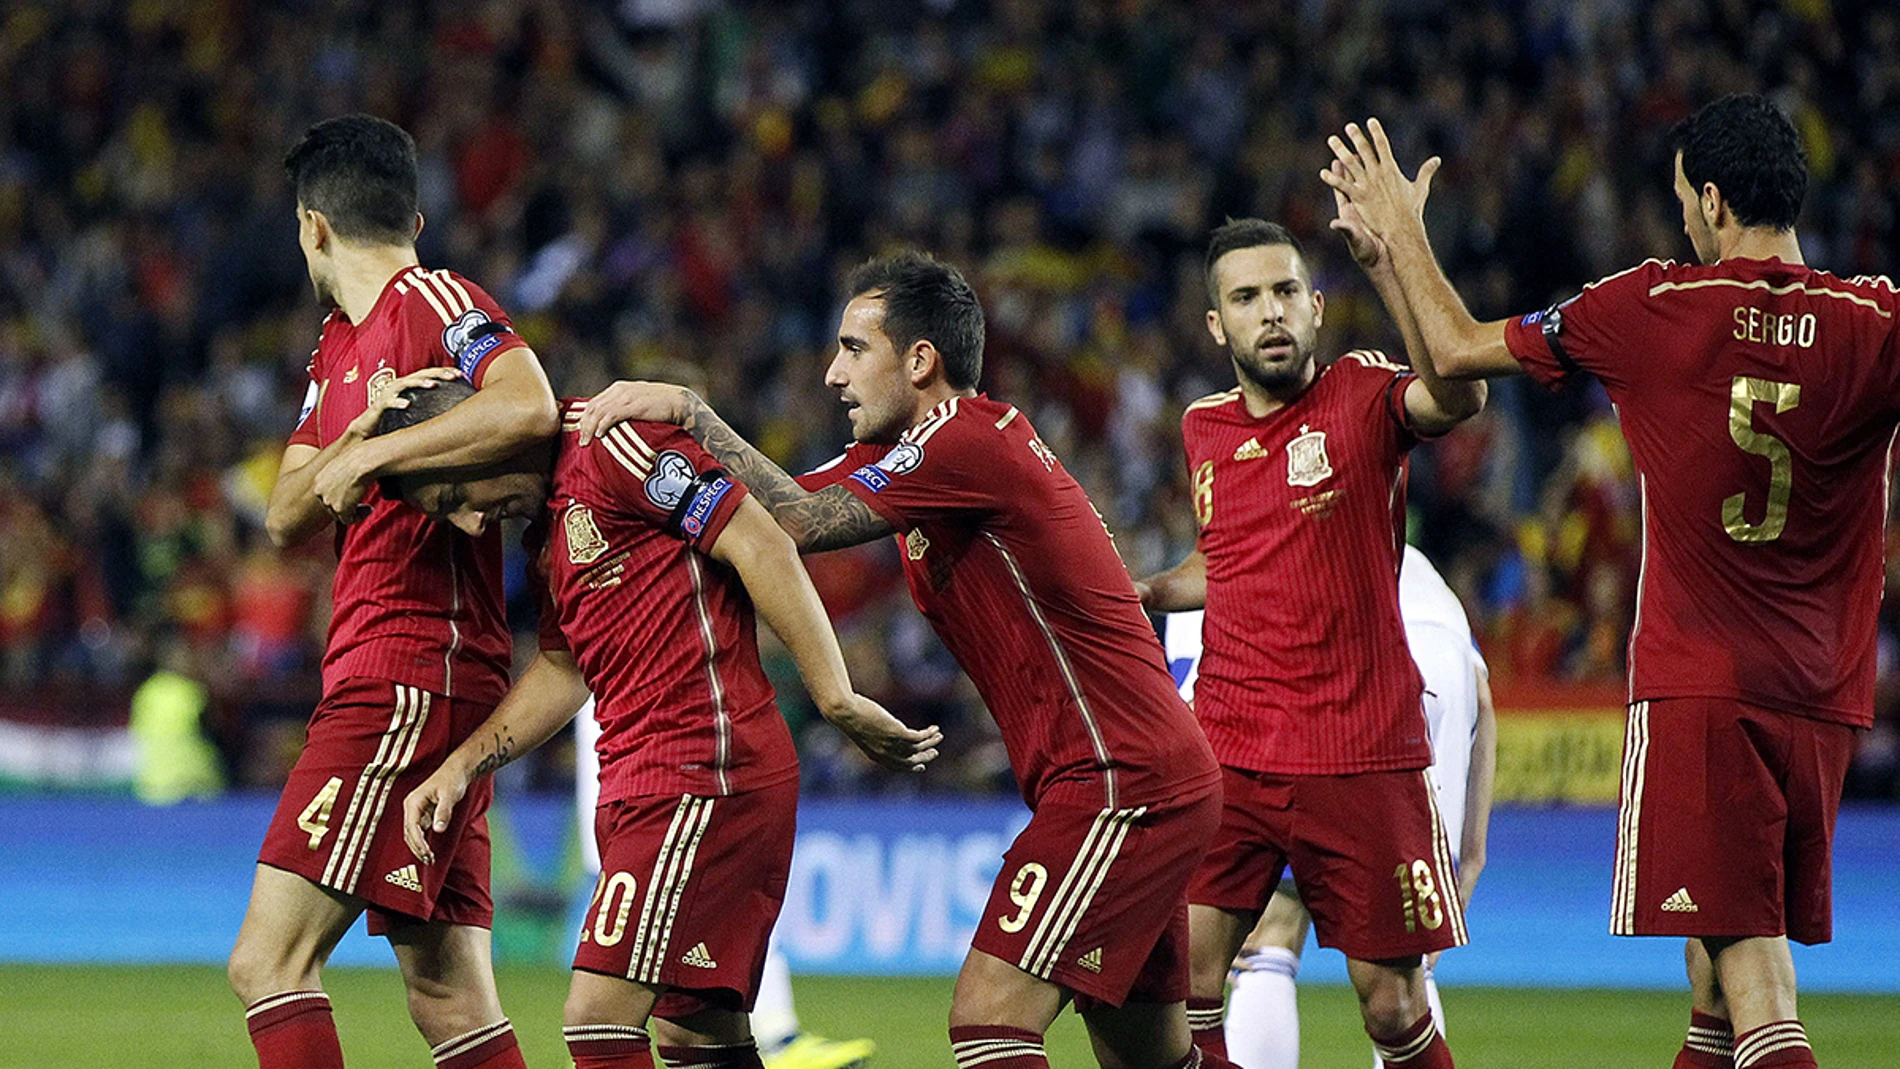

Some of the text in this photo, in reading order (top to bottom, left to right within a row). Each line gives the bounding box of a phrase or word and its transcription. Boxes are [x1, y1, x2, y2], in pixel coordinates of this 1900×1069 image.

[1732, 305, 1817, 348] SERGIO
[1721, 375, 1801, 543] 5
[692, 477, 727, 520] RESPECT
[1190, 460, 1214, 526] 8
[297, 776, 344, 850] 4
[385, 873, 423, 893] adidas
[998, 862, 1049, 933] 9
[1393, 859, 1444, 933] 18
[1661, 901, 1698, 912] adidas
[681, 955, 717, 969] adidas
